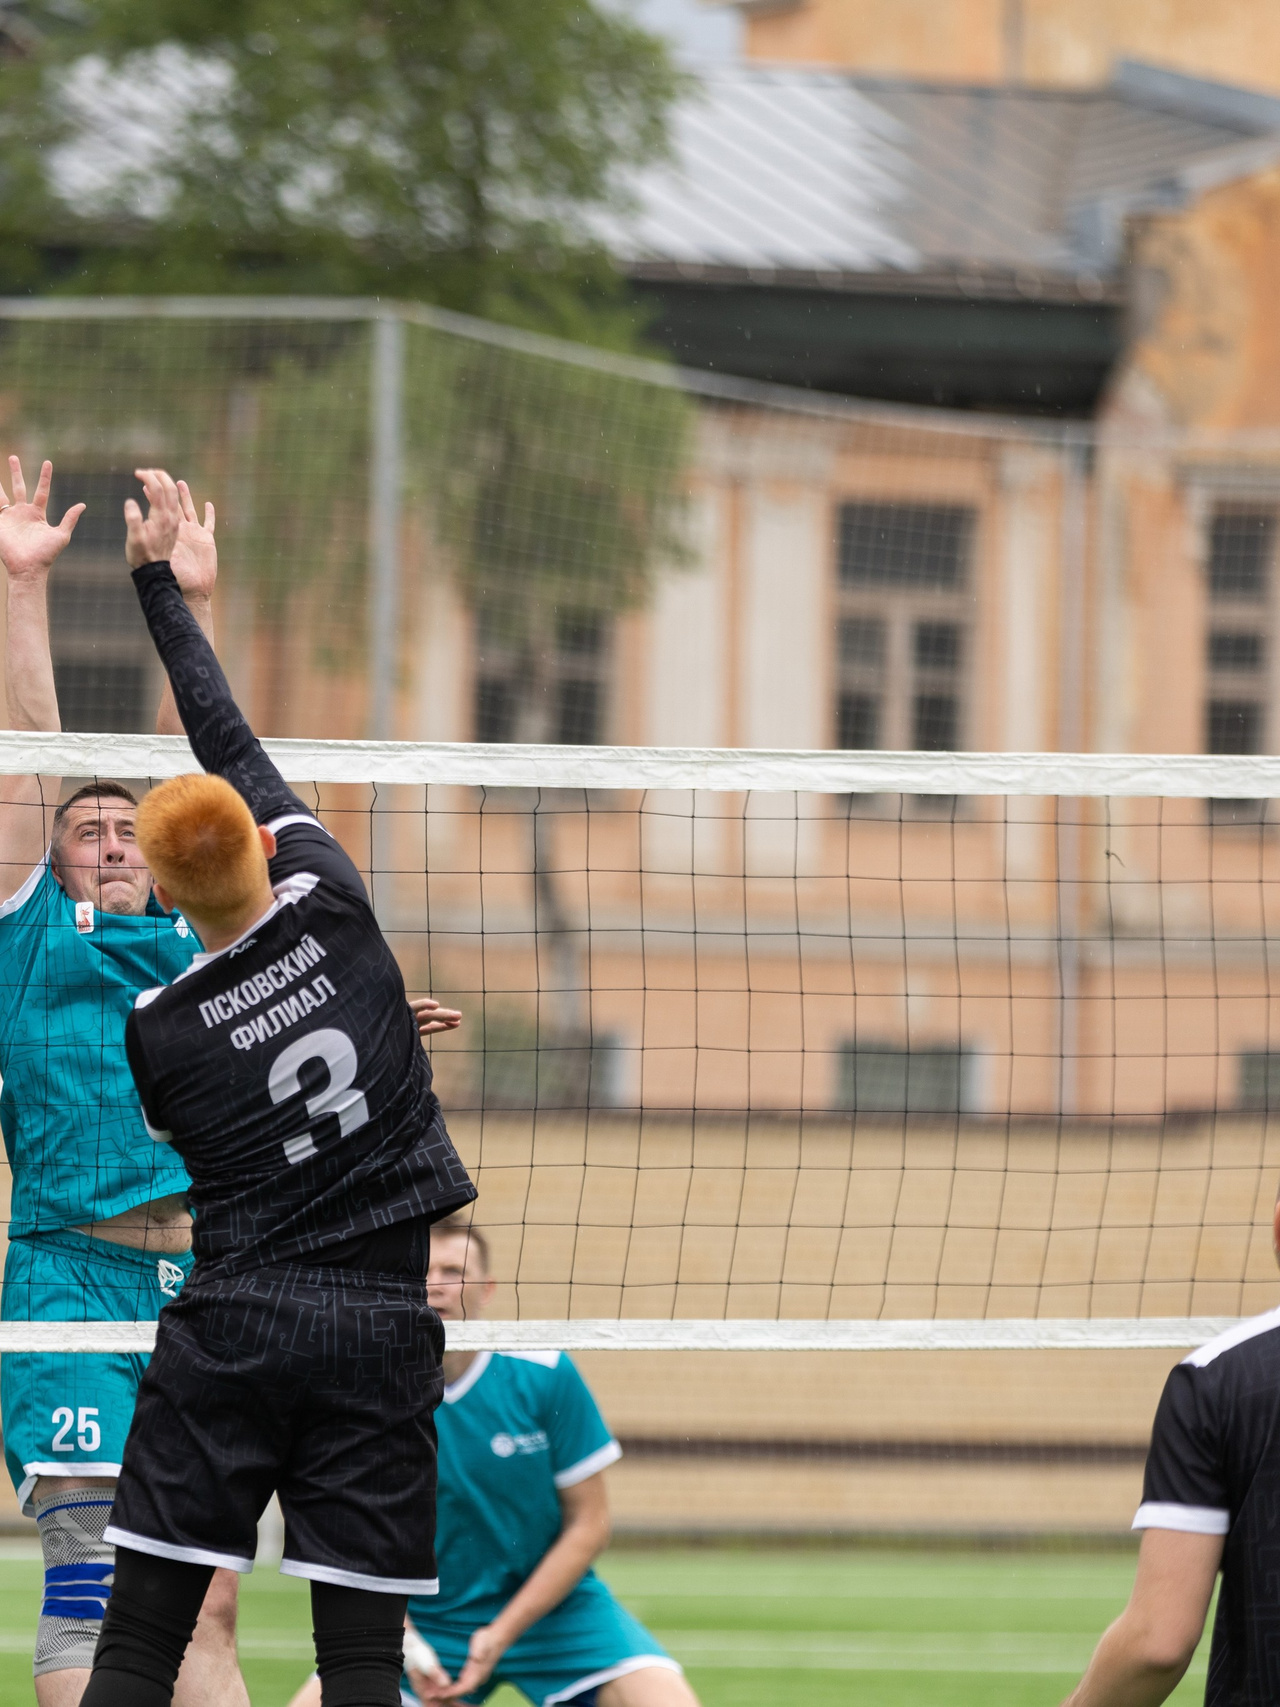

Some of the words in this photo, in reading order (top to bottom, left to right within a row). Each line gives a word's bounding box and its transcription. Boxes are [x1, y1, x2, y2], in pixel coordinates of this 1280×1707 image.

[198, 933, 327, 1028] ПСКОВСКИЙ
[230, 974, 337, 1051] ФИЛИАЛ
[268, 1028, 370, 1165] 3
[51, 1407, 102, 1452] 25
